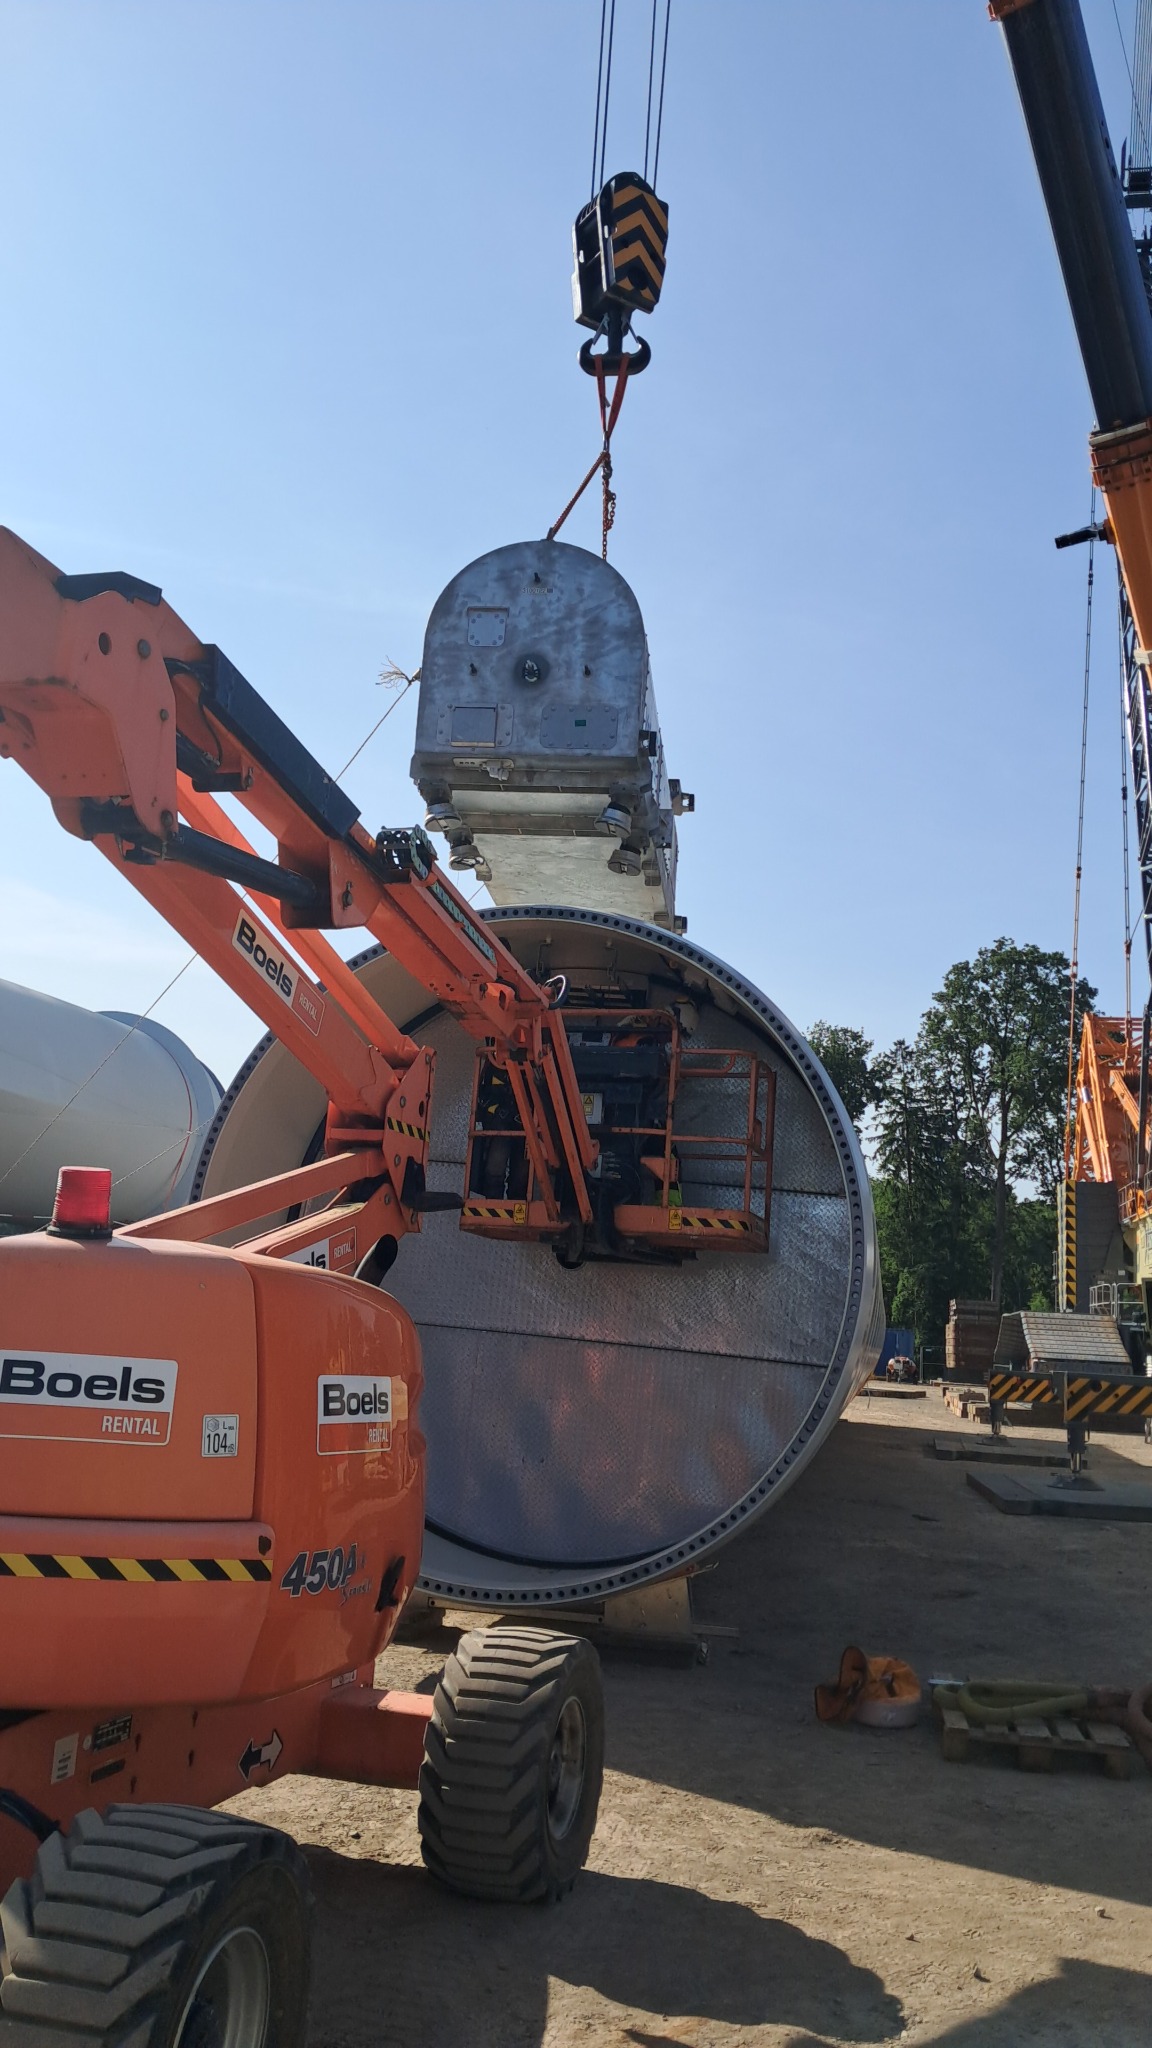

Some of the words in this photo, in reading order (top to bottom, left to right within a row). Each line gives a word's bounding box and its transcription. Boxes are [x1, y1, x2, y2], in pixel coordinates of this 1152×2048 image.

[236, 917, 293, 998] Boels
[299, 992, 317, 1021] RENTAL
[333, 1241, 352, 1259] RENTAL
[0, 1359, 165, 1404] Boels
[323, 1383, 388, 1416] Boels
[102, 1415, 161, 1435] RENTAL
[206, 1433, 227, 1453] 104
[368, 1428, 388, 1444] RENTAL
